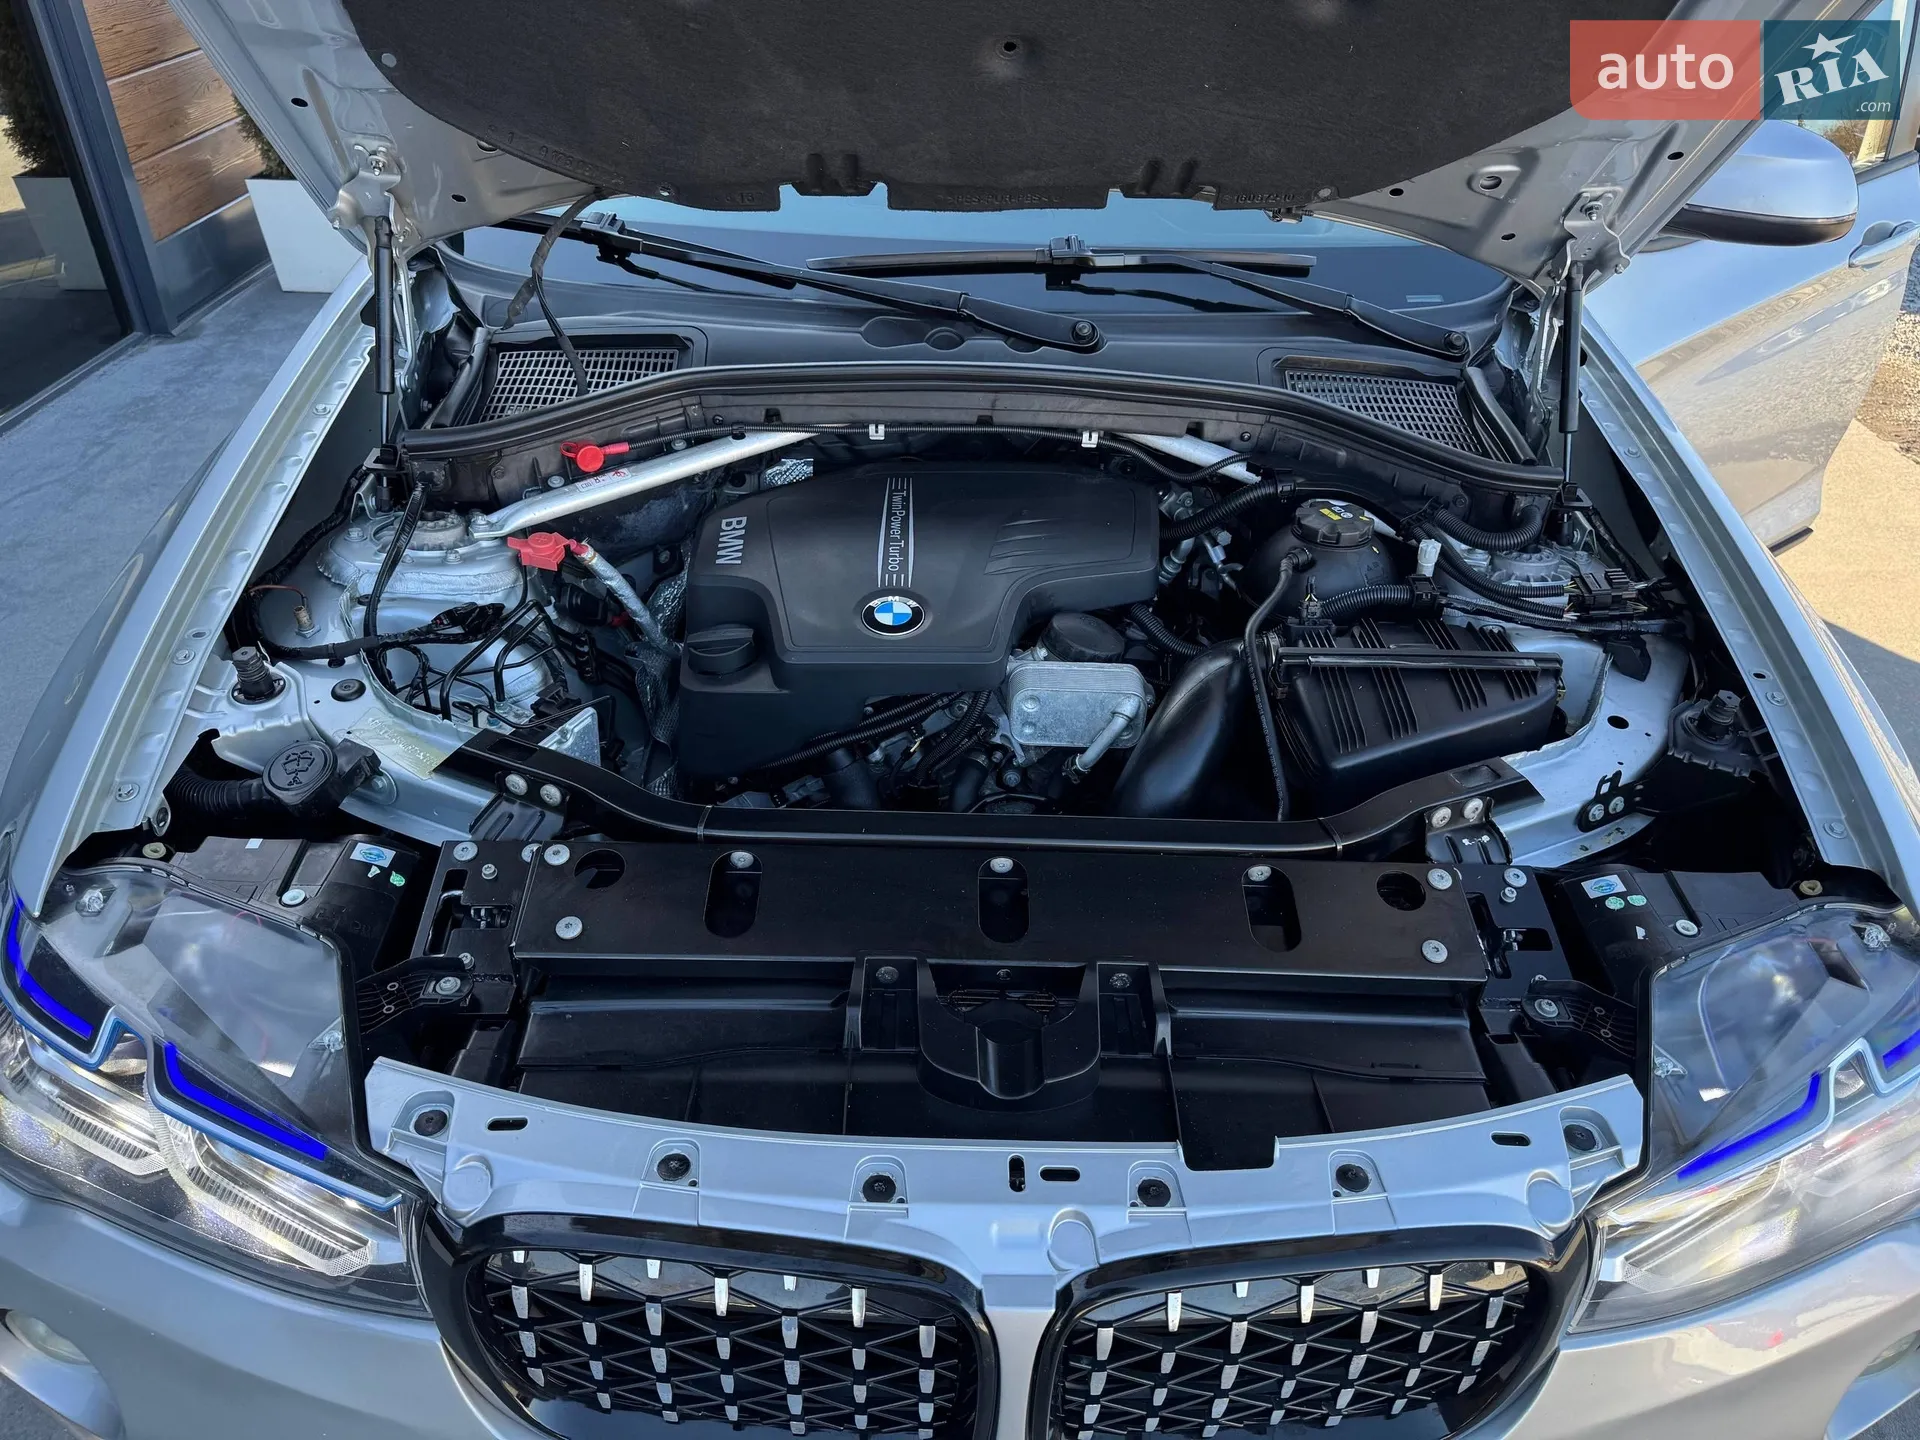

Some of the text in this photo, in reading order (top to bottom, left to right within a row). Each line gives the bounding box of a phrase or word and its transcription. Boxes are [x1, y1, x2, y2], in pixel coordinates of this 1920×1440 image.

[715, 516, 748, 565] BMW
[887, 490, 906, 572] TwinPower Turbo
[869, 595, 919, 608] BMW
